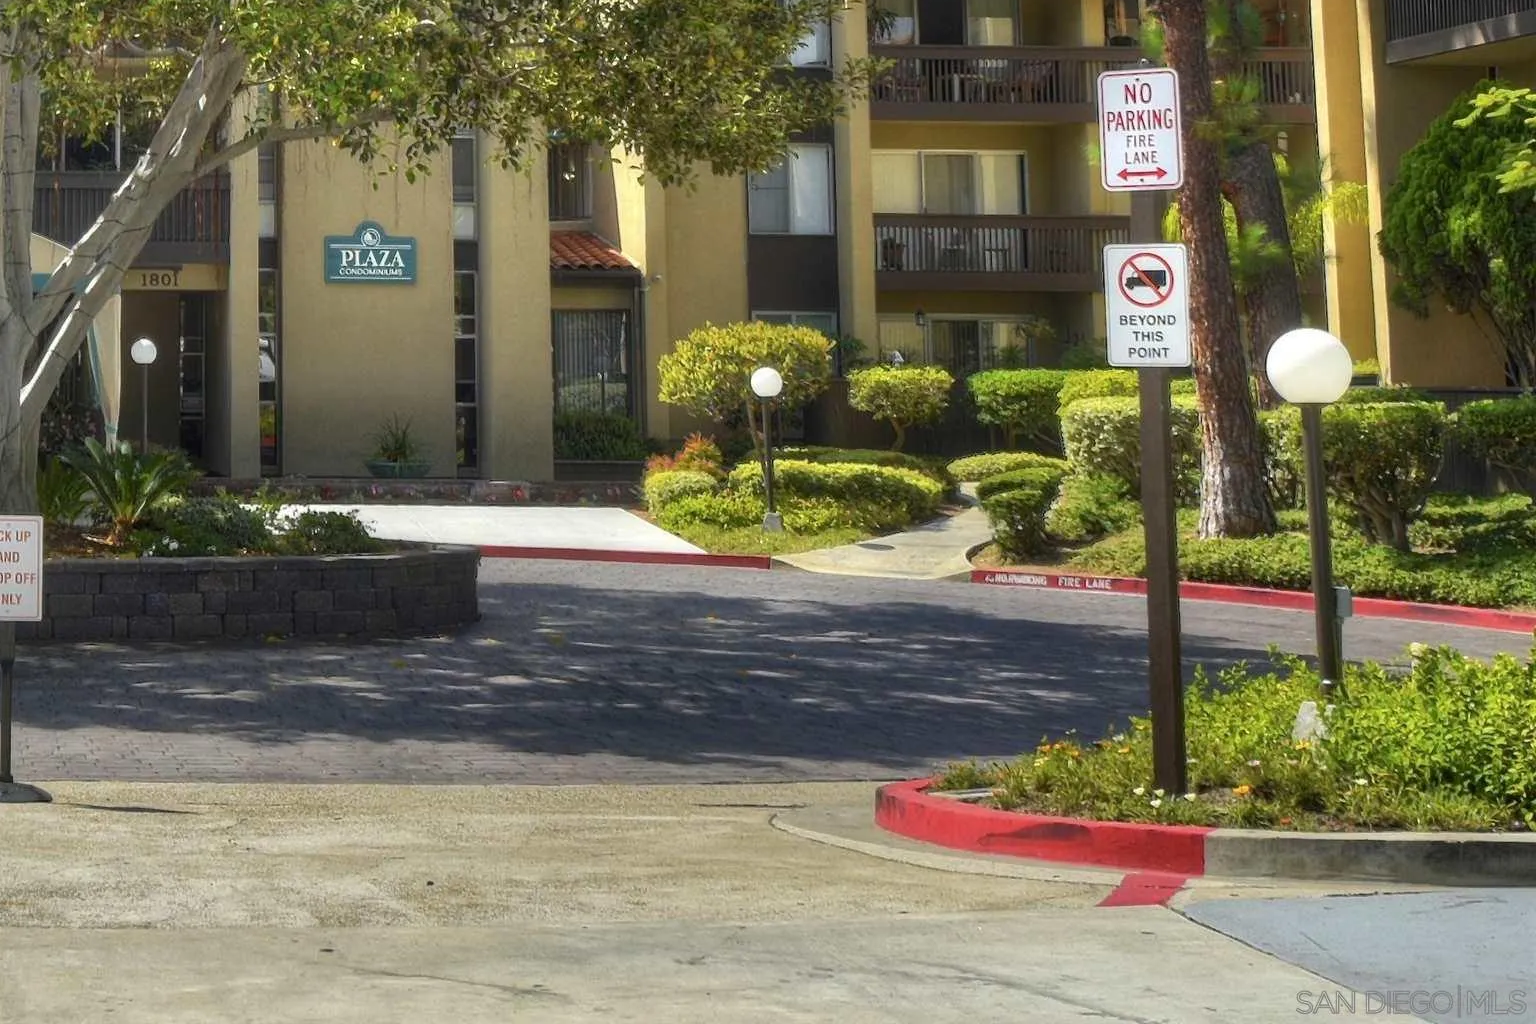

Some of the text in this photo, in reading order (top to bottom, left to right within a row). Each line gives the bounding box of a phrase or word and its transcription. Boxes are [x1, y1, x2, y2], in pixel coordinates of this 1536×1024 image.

[1124, 82, 1152, 105] NO
[1106, 108, 1173, 132] PARKING
[1126, 134, 1156, 148] FIRE
[1124, 150, 1159, 165] LANE
[340, 249, 405, 268] PLAZA
[339, 267, 403, 277] CONDOMINIUMS
[141, 271, 178, 287] 1801
[1119, 314, 1177, 326] BEYOND
[1132, 330, 1164, 342] THIS
[1128, 347, 1170, 359] POINT
[15, 530, 31, 542] UP
[15, 572, 36, 585] OFF
[1058, 577, 1081, 588] FIRE
[1085, 578, 1113, 590] LANE
